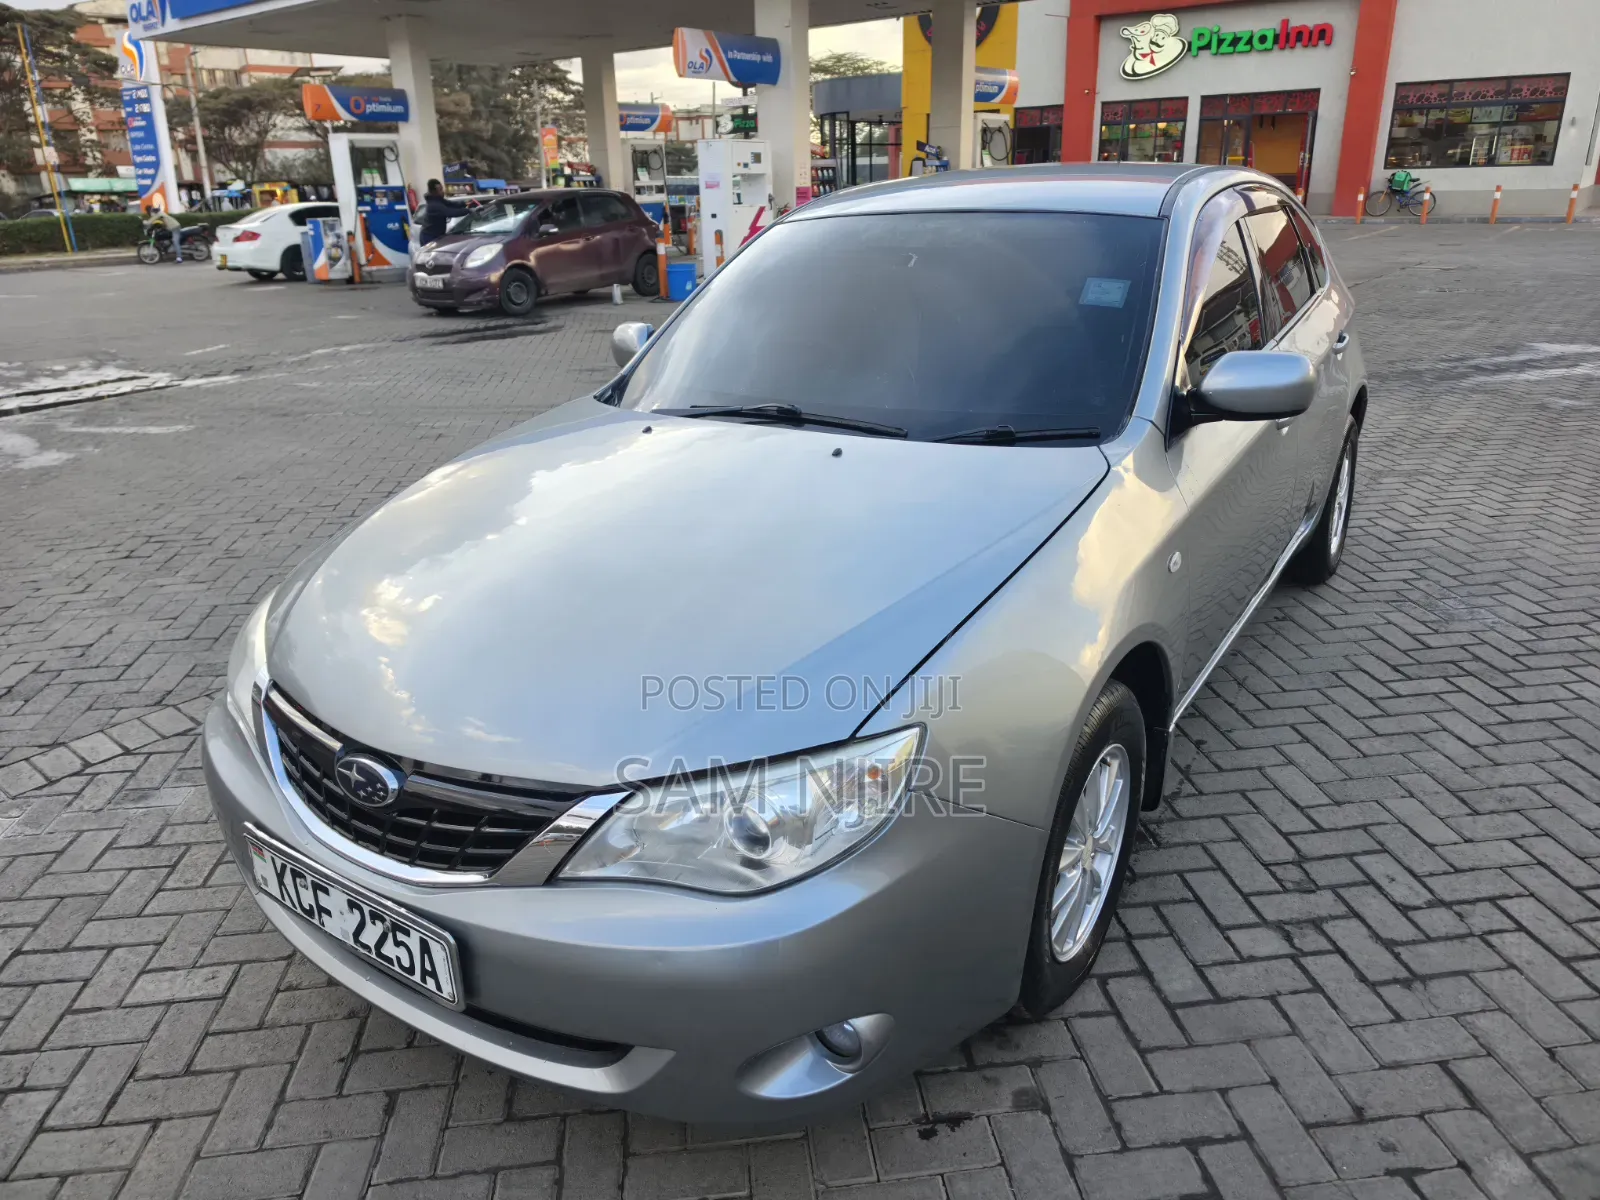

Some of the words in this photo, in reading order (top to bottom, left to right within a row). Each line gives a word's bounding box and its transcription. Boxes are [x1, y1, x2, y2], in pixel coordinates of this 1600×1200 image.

[130, 0, 156, 23] OLA
[687, 61, 705, 71] OLA
[271, 855, 333, 928] KCF
[347, 898, 444, 995] 225A
